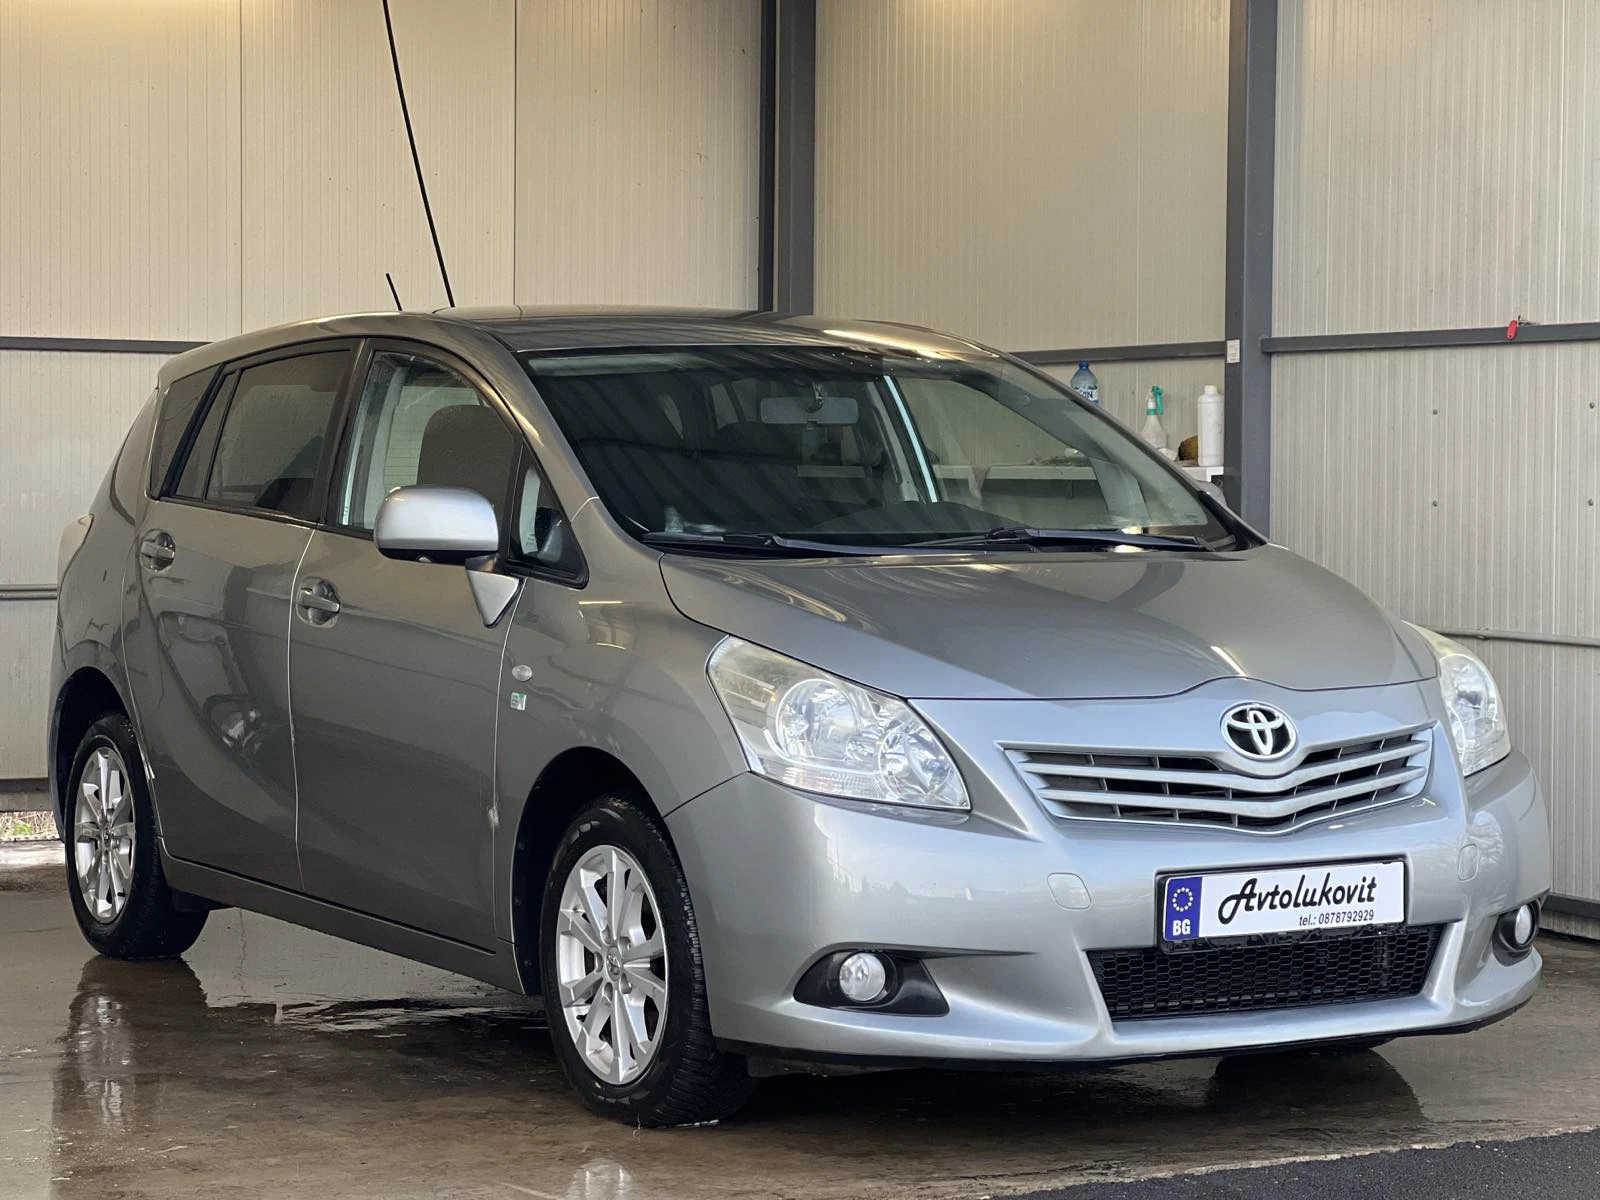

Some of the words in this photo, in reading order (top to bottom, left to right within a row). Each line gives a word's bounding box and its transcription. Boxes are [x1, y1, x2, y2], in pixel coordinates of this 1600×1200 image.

[1218, 872, 1377, 925] Avtolukovit
[1299, 914, 1317, 926] tel.:
[1318, 909, 1374, 924] 0878792929
[1172, 919, 1190, 936] BG
